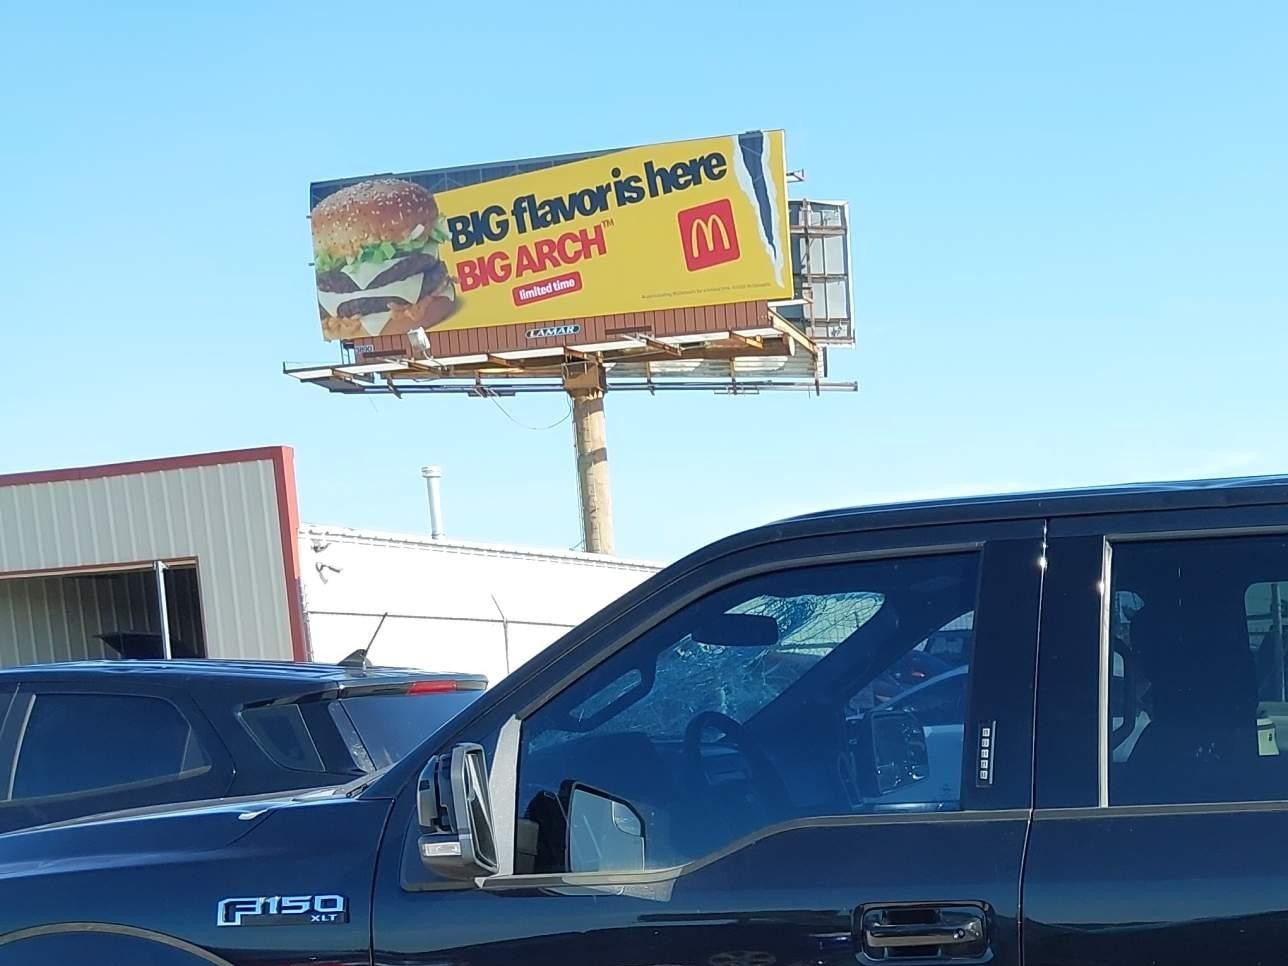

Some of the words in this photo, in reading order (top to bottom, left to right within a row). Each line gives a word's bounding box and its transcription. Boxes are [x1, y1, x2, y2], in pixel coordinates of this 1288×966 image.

[447, 205, 510, 252] BIG
[511, 183, 612, 234] flavor
[611, 168, 646, 207] is
[643, 152, 728, 198] here
[456, 251, 512, 292] BIG
[519, 282, 552, 301] limited
[552, 279, 576, 293] time
[529, 325, 576, 338] LAMAR
[310, 913, 338, 922] XLT
